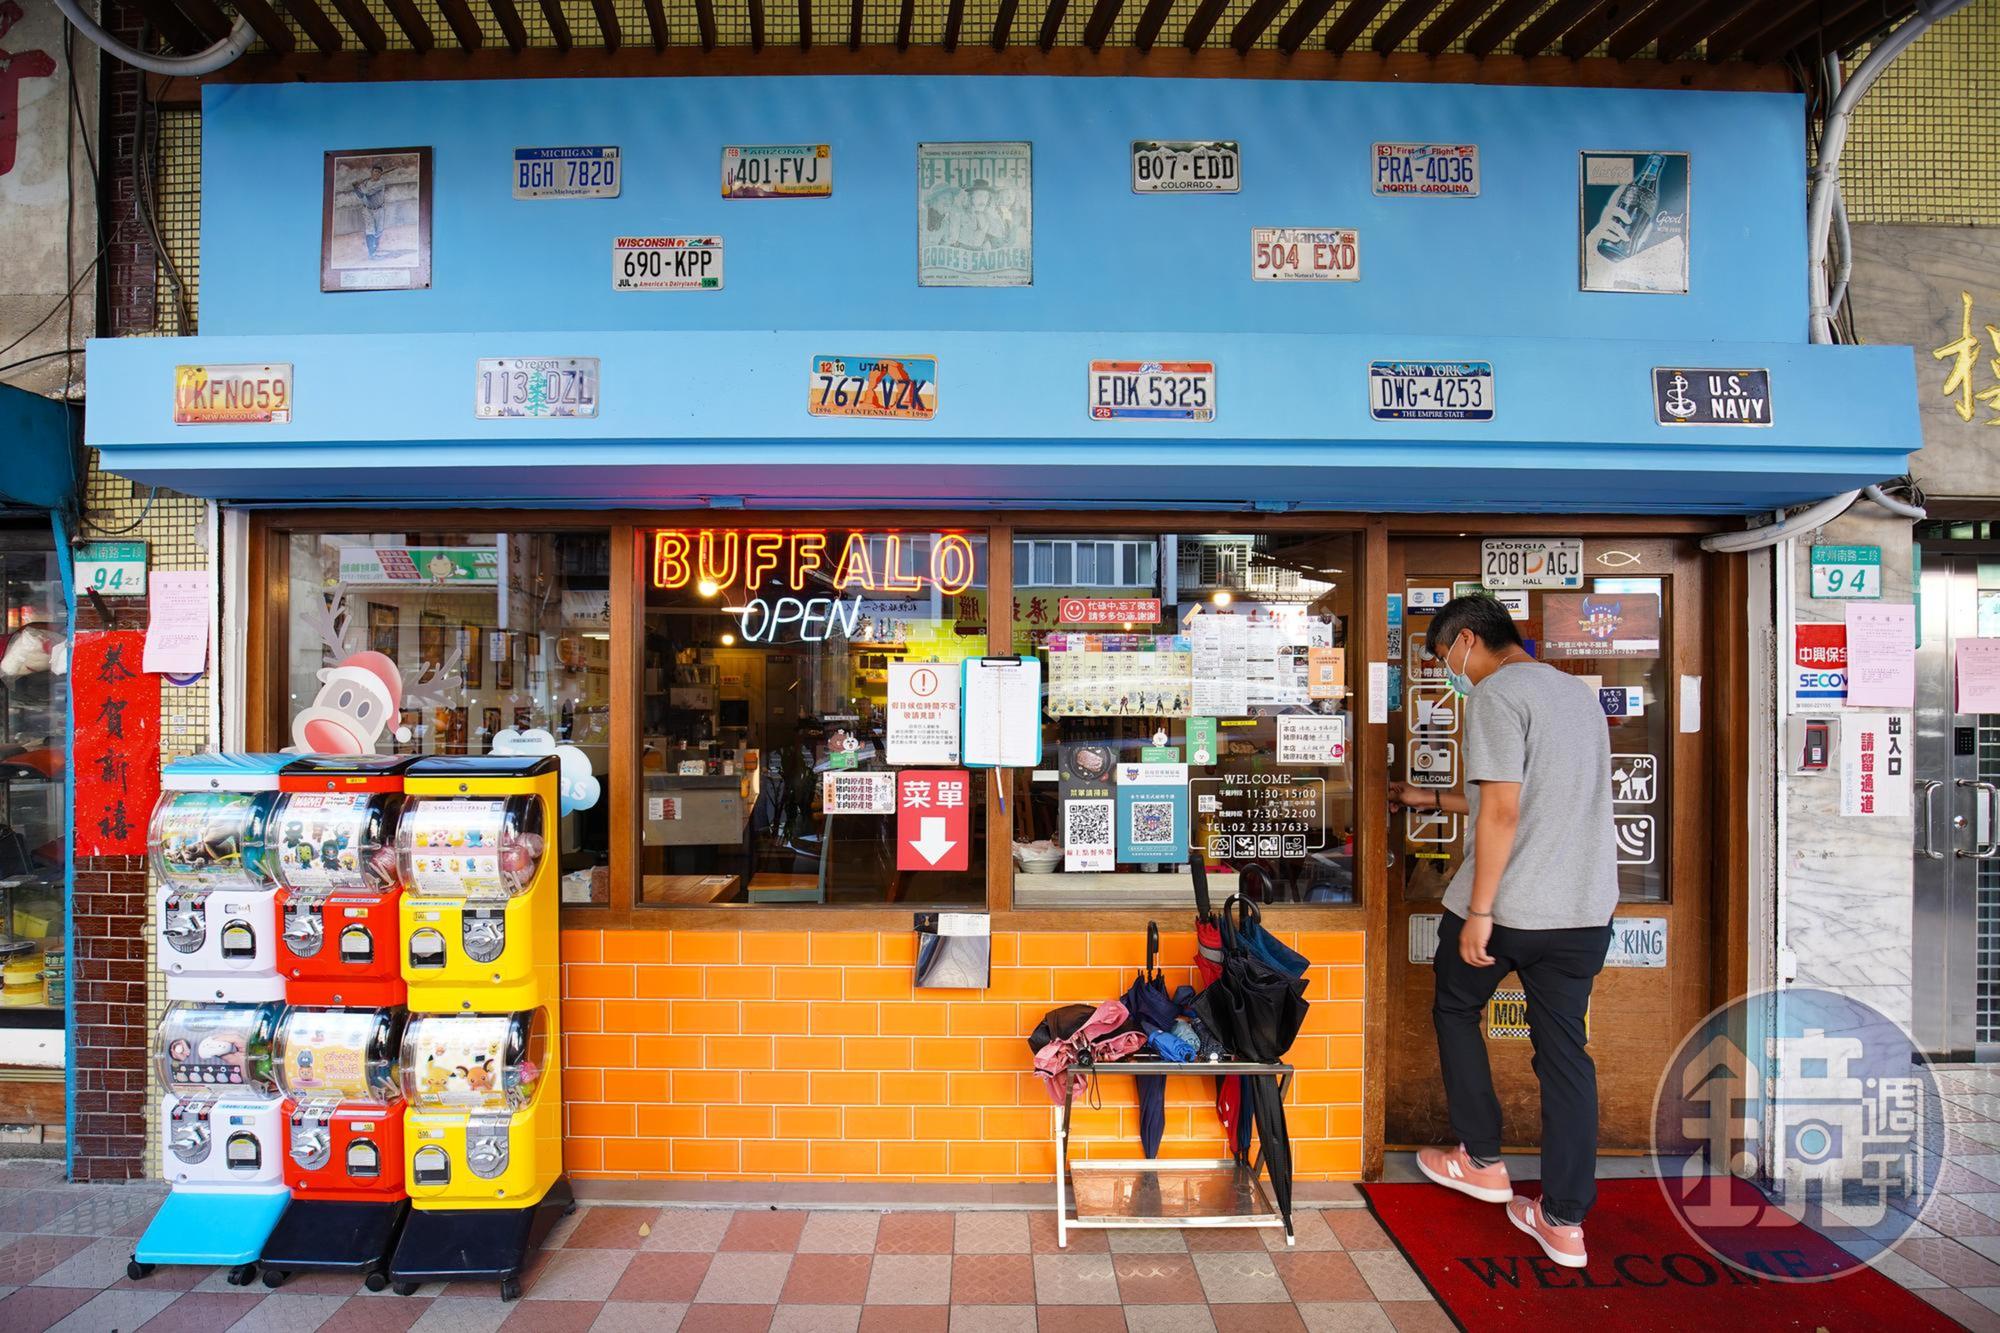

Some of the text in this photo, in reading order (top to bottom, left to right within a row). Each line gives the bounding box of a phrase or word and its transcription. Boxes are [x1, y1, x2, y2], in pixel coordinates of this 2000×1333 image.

[541, 149, 593, 157] MICHIGAN
[519, 160, 614, 188] BGH 7820
[1378, 157, 1473, 182] PRA-4036
[1160, 181, 1213, 189] COLORADO
[1383, 184, 1469, 192] NORTH CAROLINA
[1656, 210, 1683, 225] Good
[618, 238, 675, 247] WISCONSIN
[1277, 229, 1335, 244] Arkansas
[624, 251, 712, 277] 690-KPP
[1257, 244, 1355, 270] 504 EXD
[618, 279, 631, 287] JUL
[515, 360, 559, 371] Oregon
[821, 362, 832, 372] 12
[836, 363, 844, 372] 10
[859, 362, 889, 372] UTAH
[1399, 364, 1463, 376] NEW YORK
[820, 376, 926, 410] 767 VZK
[1098, 376, 1206, 407] EDK 5325
[1381, 378, 1482, 407] DWG 4253
[1709, 375, 1747, 396] U.S.
[845, 408, 898, 416] CENTENNIAL
[1096, 408, 1110, 417] 25
[1711, 399, 1764, 418] NAVY
[653, 532, 975, 595] BUFFALO
[1487, 552, 1578, 575] 2081 AGJ
[1815, 550, 1877, 562] 杭州南路二段
[93, 567, 123, 591] 94
[1827, 569, 1866, 592] 94
[741, 595, 862, 642] OPEN
[1887, 717, 1902, 776] 出入口
[1633, 758, 1651, 769] OK
[1224, 774, 1291, 784] WELCOME
[1861, 732, 1875, 814] 請留通道
[903, 780, 964, 809] 菜單
[1246, 789, 1316, 798] 11:30-15:00
[1246, 809, 1316, 818] 17:30-22:00
[1207, 823, 1309, 832] TEL:02 23517633
[1624, 929, 1663, 955] KING
